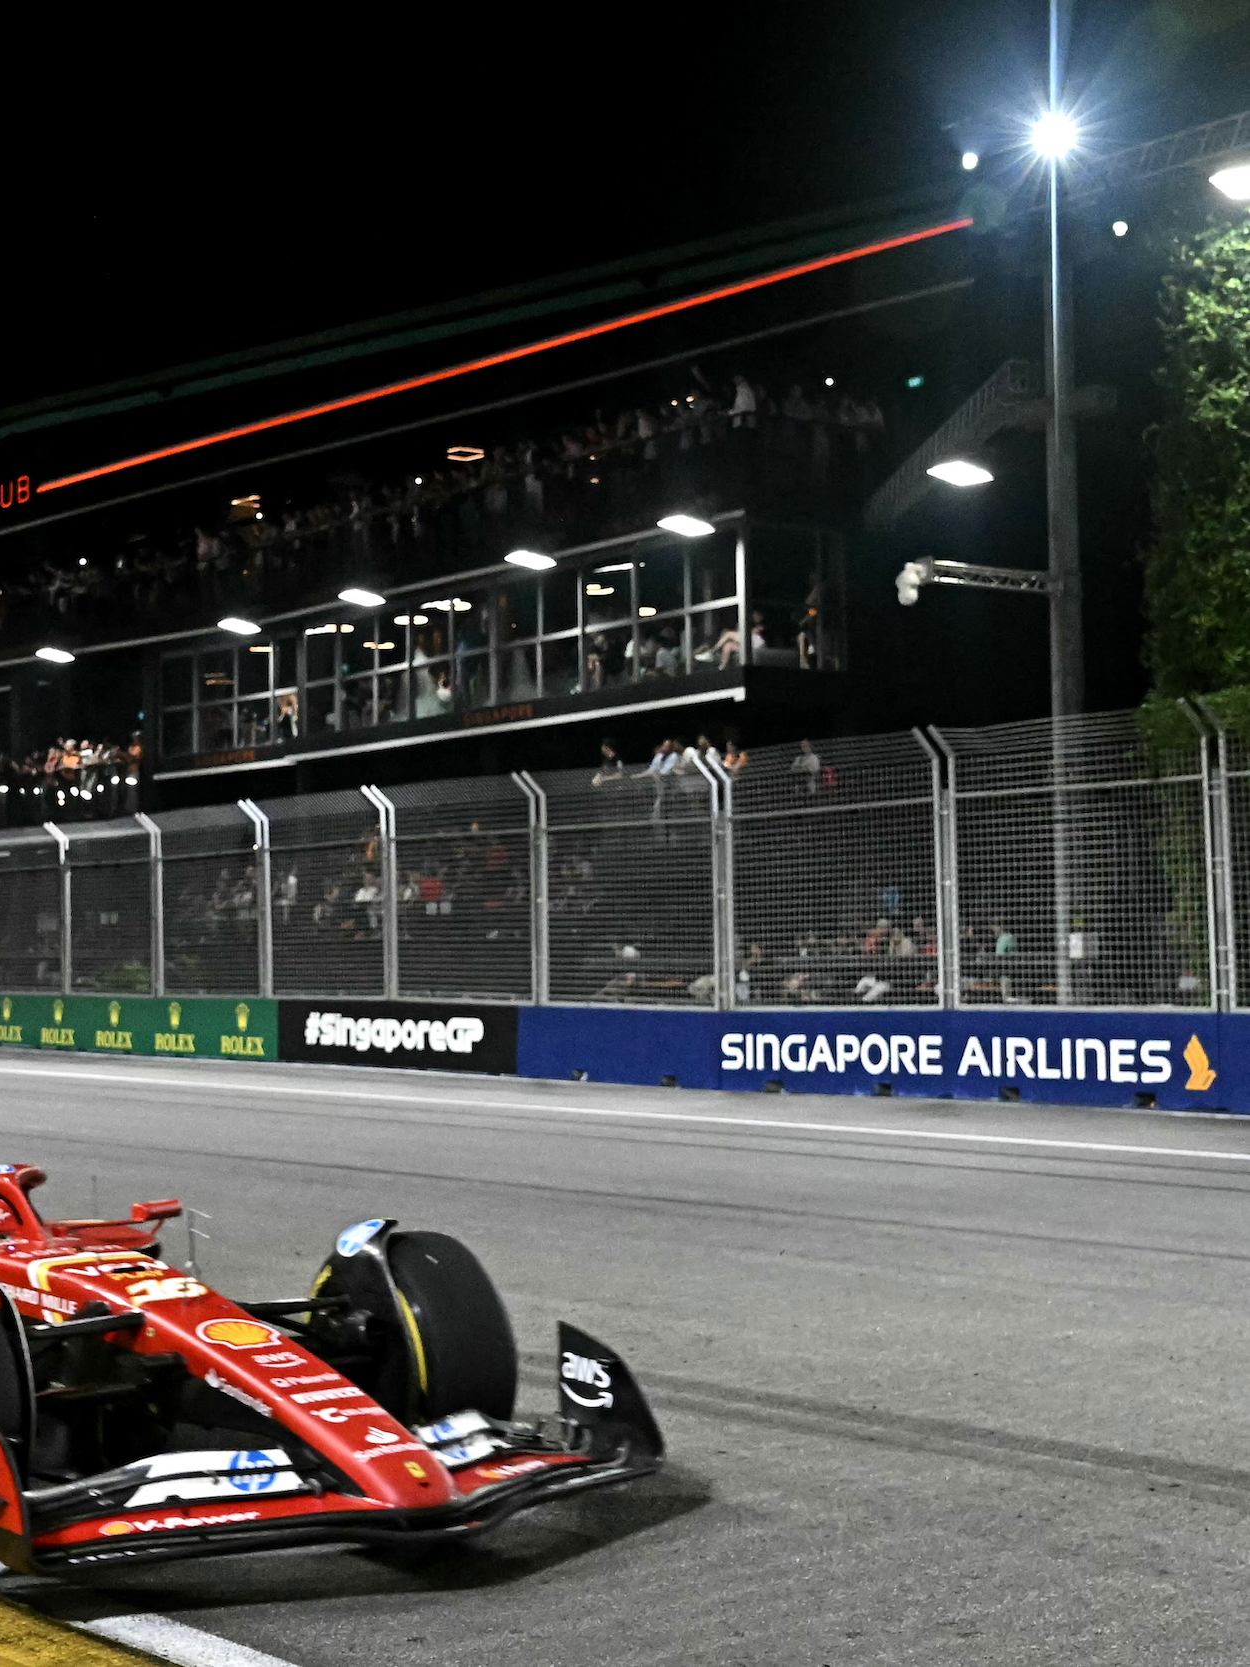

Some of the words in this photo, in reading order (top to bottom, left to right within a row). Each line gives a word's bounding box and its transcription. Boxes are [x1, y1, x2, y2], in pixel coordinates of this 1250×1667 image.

[41, 1027, 75, 1046] ROLEX
[96, 1030, 132, 1049] ROLEX
[155, 1033, 195, 1053] ROLEX
[304, 1011, 485, 1053] #SingaporeGP
[221, 1035, 265, 1056] ROLEX
[721, 1033, 943, 1075] SINGAPORE
[957, 1036, 1172, 1083] AIRLINES
[126, 1276, 208, 1307] 16
[41, 1293, 78, 1315] MILLE
[252, 1351, 301, 1366] aws
[562, 1351, 612, 1389] aws
[132, 1511, 261, 1533] V-Power
